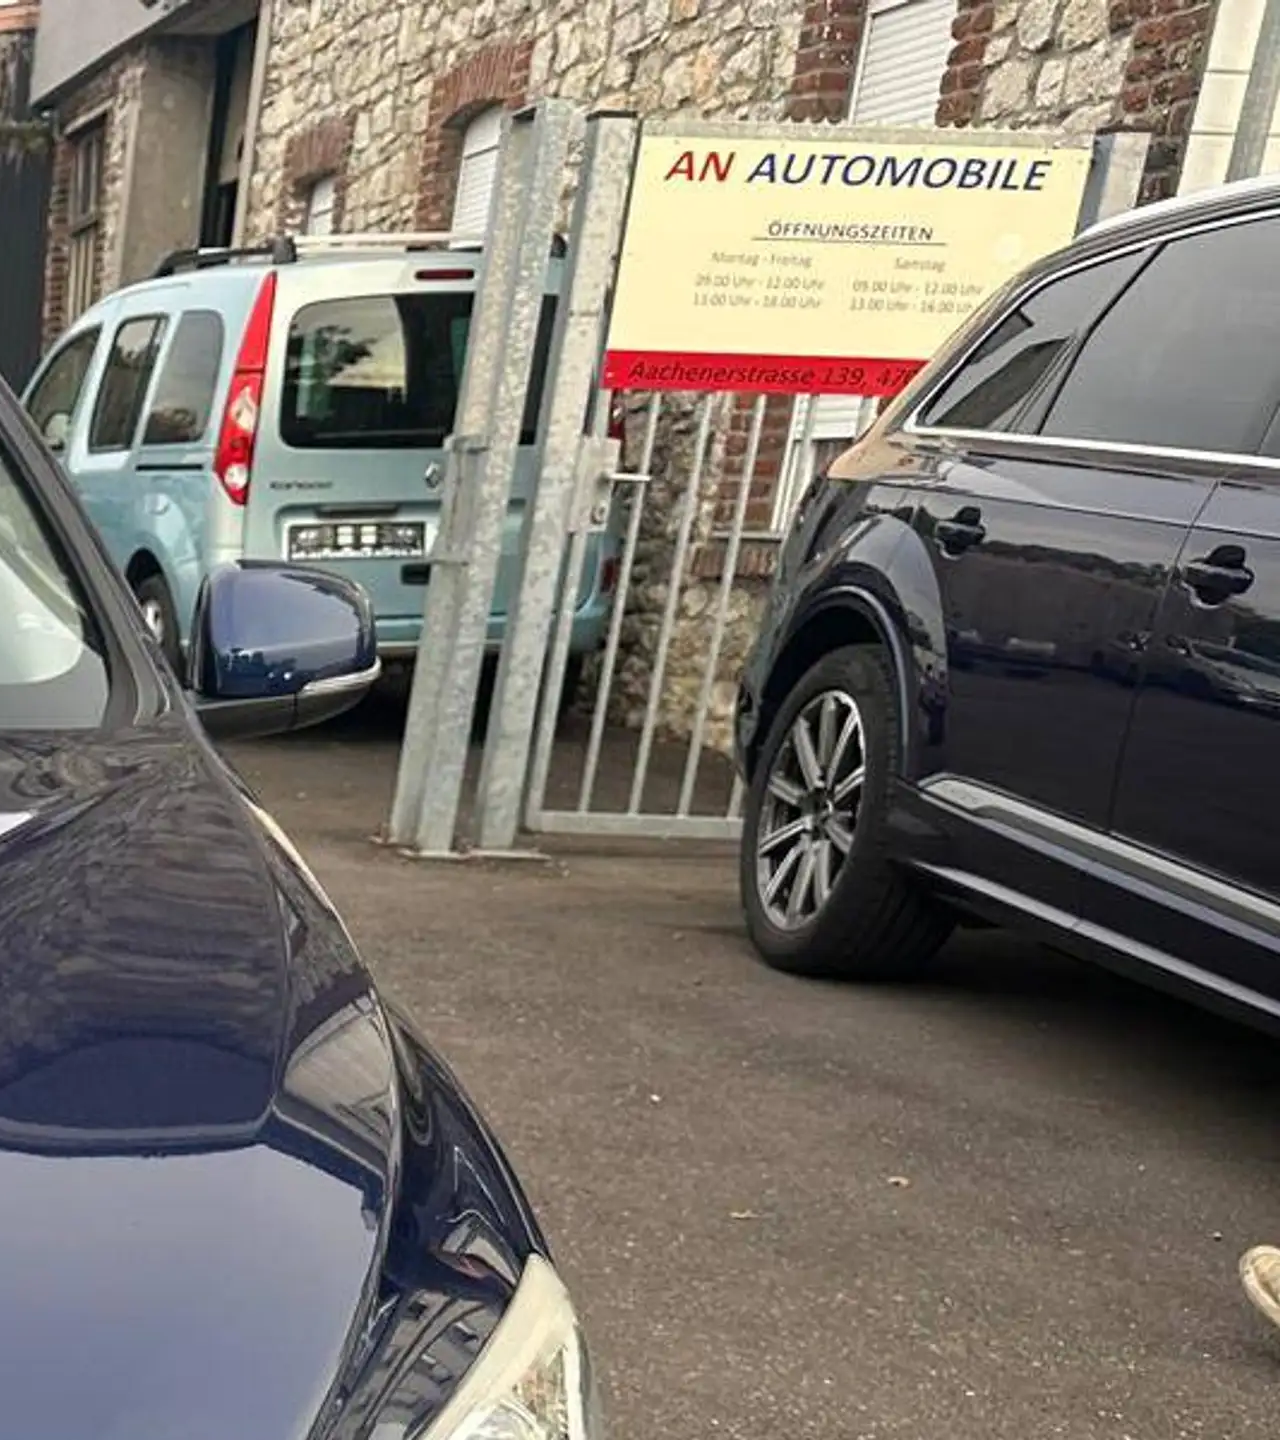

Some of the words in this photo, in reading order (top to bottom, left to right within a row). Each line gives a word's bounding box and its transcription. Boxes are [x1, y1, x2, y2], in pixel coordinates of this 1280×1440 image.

[664, 150, 736, 183] AN
[746, 152, 1053, 192] AUTOMOBILE
[766, 219, 935, 241] ÖFFNUNGSZEITEN
[627, 360, 815, 386] Aachenerstrasse
[823, 365, 867, 388] 139,
